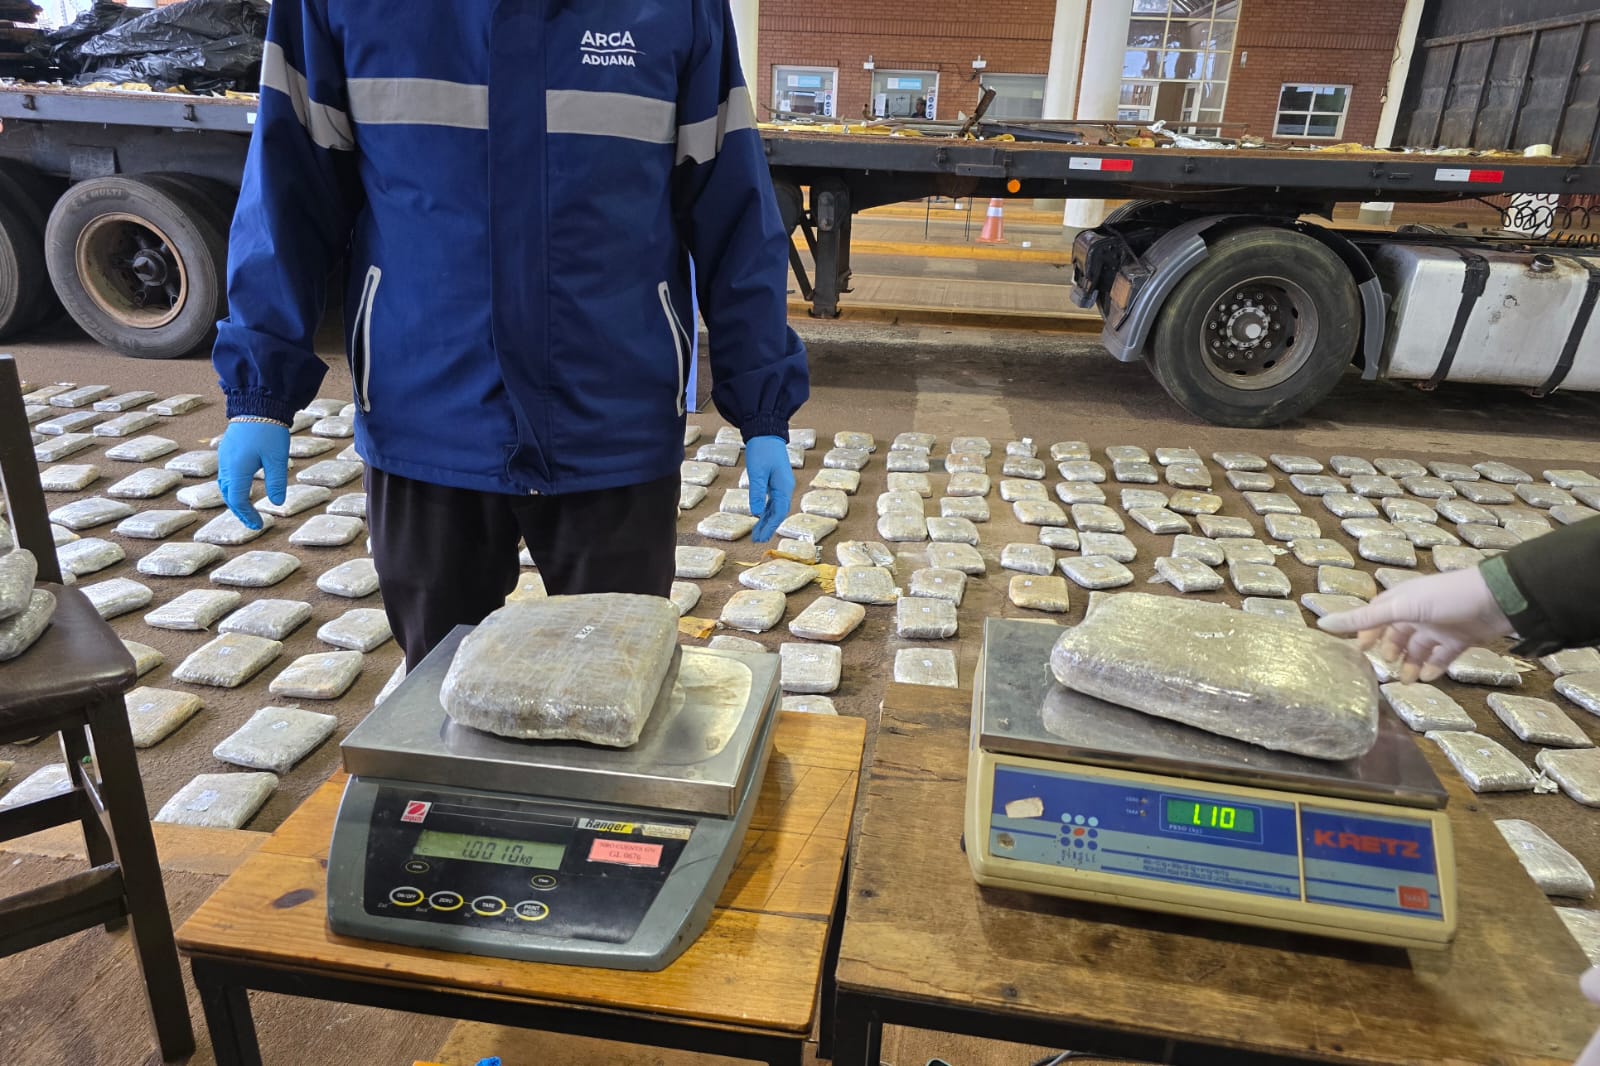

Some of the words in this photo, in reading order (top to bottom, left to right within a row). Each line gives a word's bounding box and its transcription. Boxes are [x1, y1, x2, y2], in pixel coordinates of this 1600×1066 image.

[580, 30, 636, 47] ARCA
[582, 54, 636, 67] ADUANA
[1193, 804, 1235, 829] 1.10
[585, 819, 627, 832] Ranger
[1314, 829, 1421, 859] KRETZ
